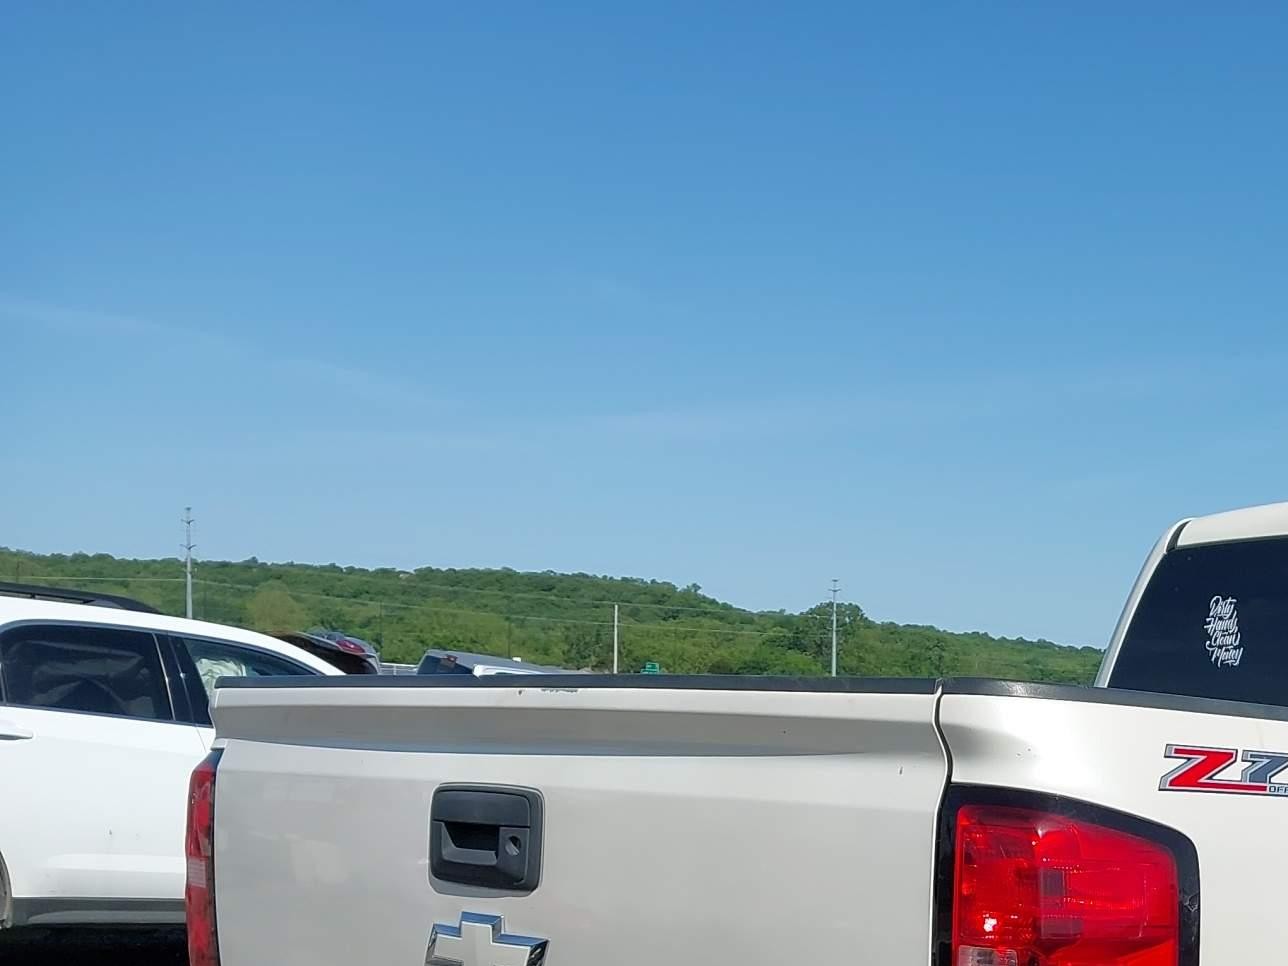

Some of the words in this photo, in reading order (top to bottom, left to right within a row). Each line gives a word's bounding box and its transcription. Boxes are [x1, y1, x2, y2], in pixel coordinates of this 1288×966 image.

[1209, 596, 1237, 619] Dirty
[1204, 611, 1238, 636] Hands
[1212, 631, 1240, 646] Clean
[1206, 641, 1243, 667] Money
